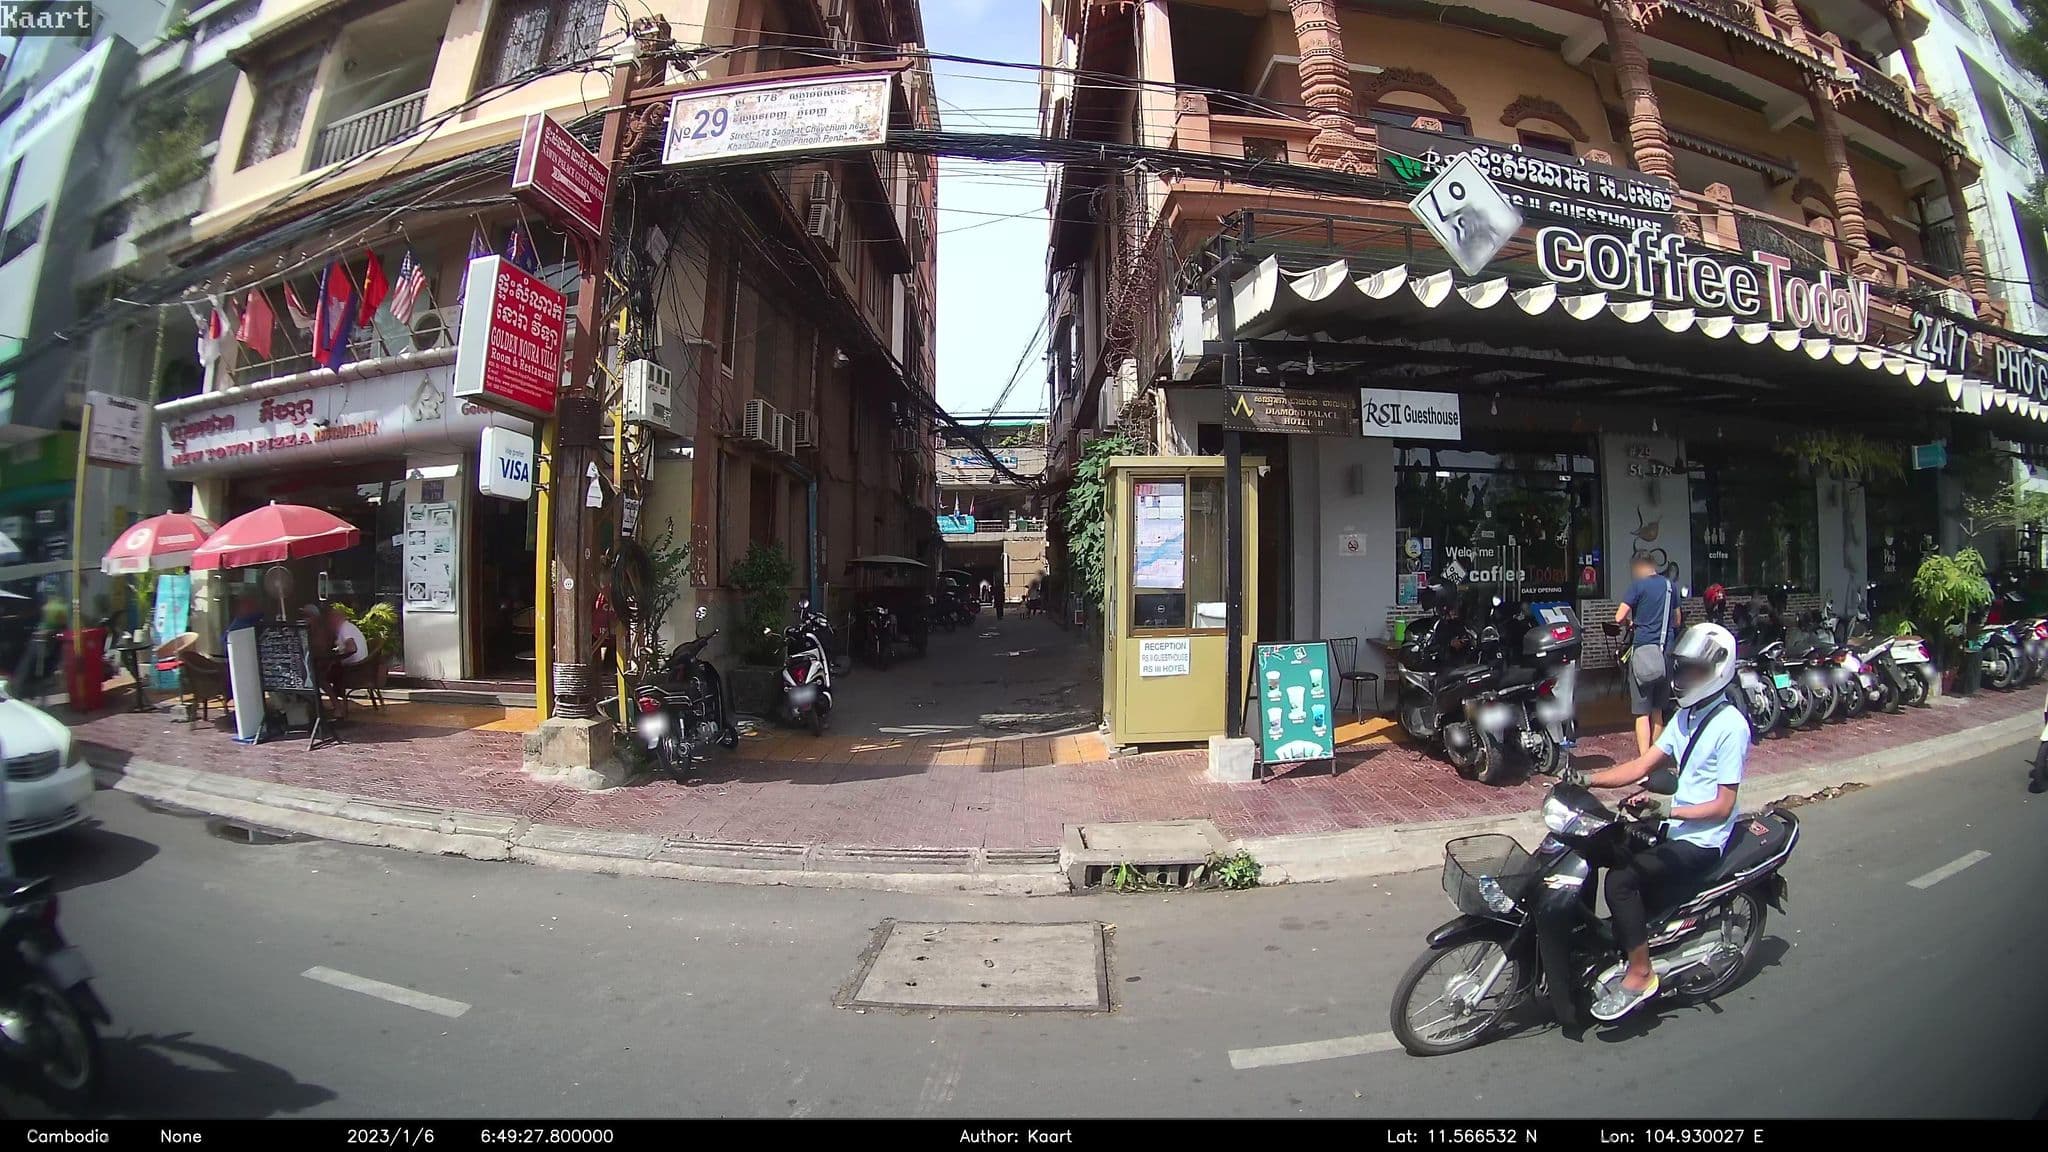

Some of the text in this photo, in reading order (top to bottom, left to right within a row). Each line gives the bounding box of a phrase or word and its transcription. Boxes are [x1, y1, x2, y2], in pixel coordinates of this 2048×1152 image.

[690, 107, 729, 140] 29
[575, 170, 590, 190] GUEST
[490, 326, 519, 355] GOLDEN
[518, 336, 540, 364] NOURA
[540, 348, 557, 372] VILLA
[1911, 310, 1969, 371] 24/7
[491, 347, 511, 365] Room
[519, 359, 555, 383] Restaurant
[1265, 407, 1337, 419] DIAMOND PALACE
[1284, 418, 1311, 427] HOTEL
[1403, 404, 1459, 426] Guesthouse
[171, 450, 204, 467] NEW
[206, 441, 253, 461] TOWN
[256, 432, 313, 453] PIZZA
[314, 420, 379, 443] RESTAURANT
[498, 456, 529, 483] VISA
[1469, 565, 1526, 582] coffee
[1537, 586, 1562, 594] OPENING
[1144, 641, 1187, 651] RECEPTION
[1162, 664, 1187, 673] HOTEL
